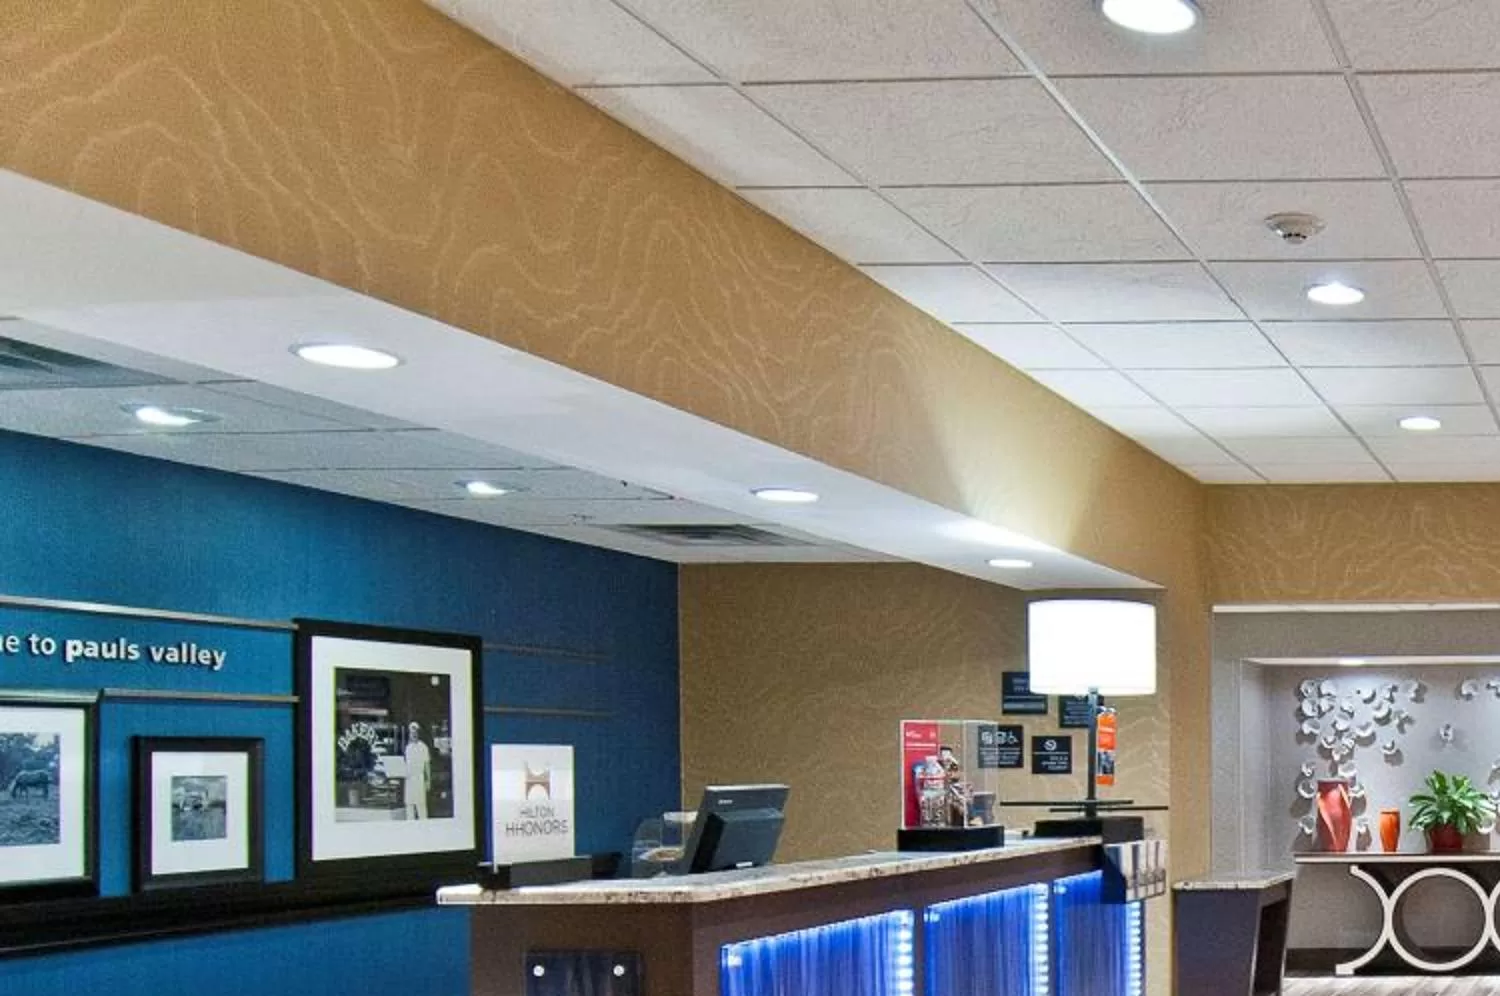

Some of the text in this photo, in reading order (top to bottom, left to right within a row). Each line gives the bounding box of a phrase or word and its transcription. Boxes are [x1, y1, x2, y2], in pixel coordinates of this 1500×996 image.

[0, 632, 227, 670] e to pauls valley
[504, 818, 569, 838] HHONORS
